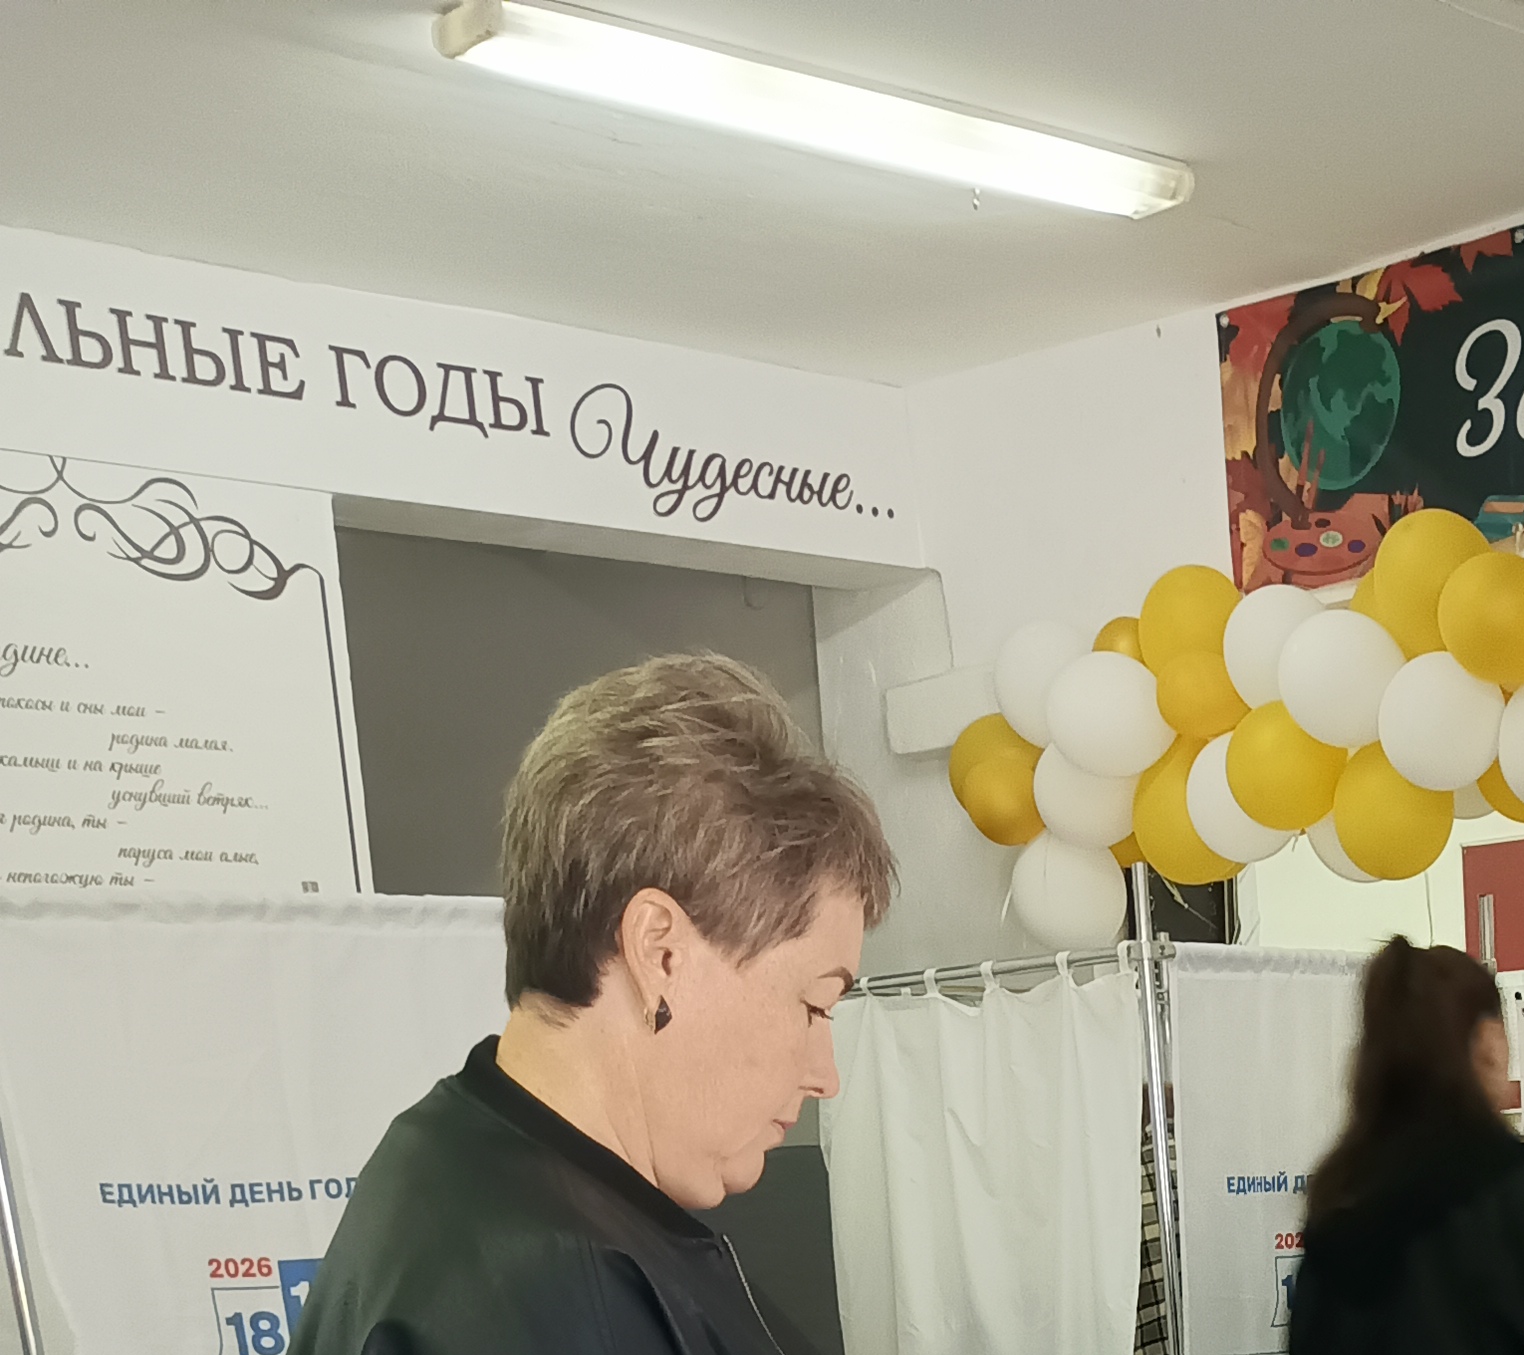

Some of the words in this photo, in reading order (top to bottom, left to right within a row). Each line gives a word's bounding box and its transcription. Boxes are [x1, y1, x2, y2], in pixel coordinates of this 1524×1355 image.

[4, 292, 306, 401] ЛЬНЫЕ
[328, 344, 551, 439] ГОДЫ
[570, 382, 895, 522] Чудесные...
[99, 1178, 221, 1208] ЕДИНЫЙ
[229, 1180, 303, 1208] ДЕНЬ
[1226, 1171, 1288, 1195] ЕДИНЫЙ
[1274, 1231, 1305, 1250] 202
[208, 1257, 273, 1279] 2026
